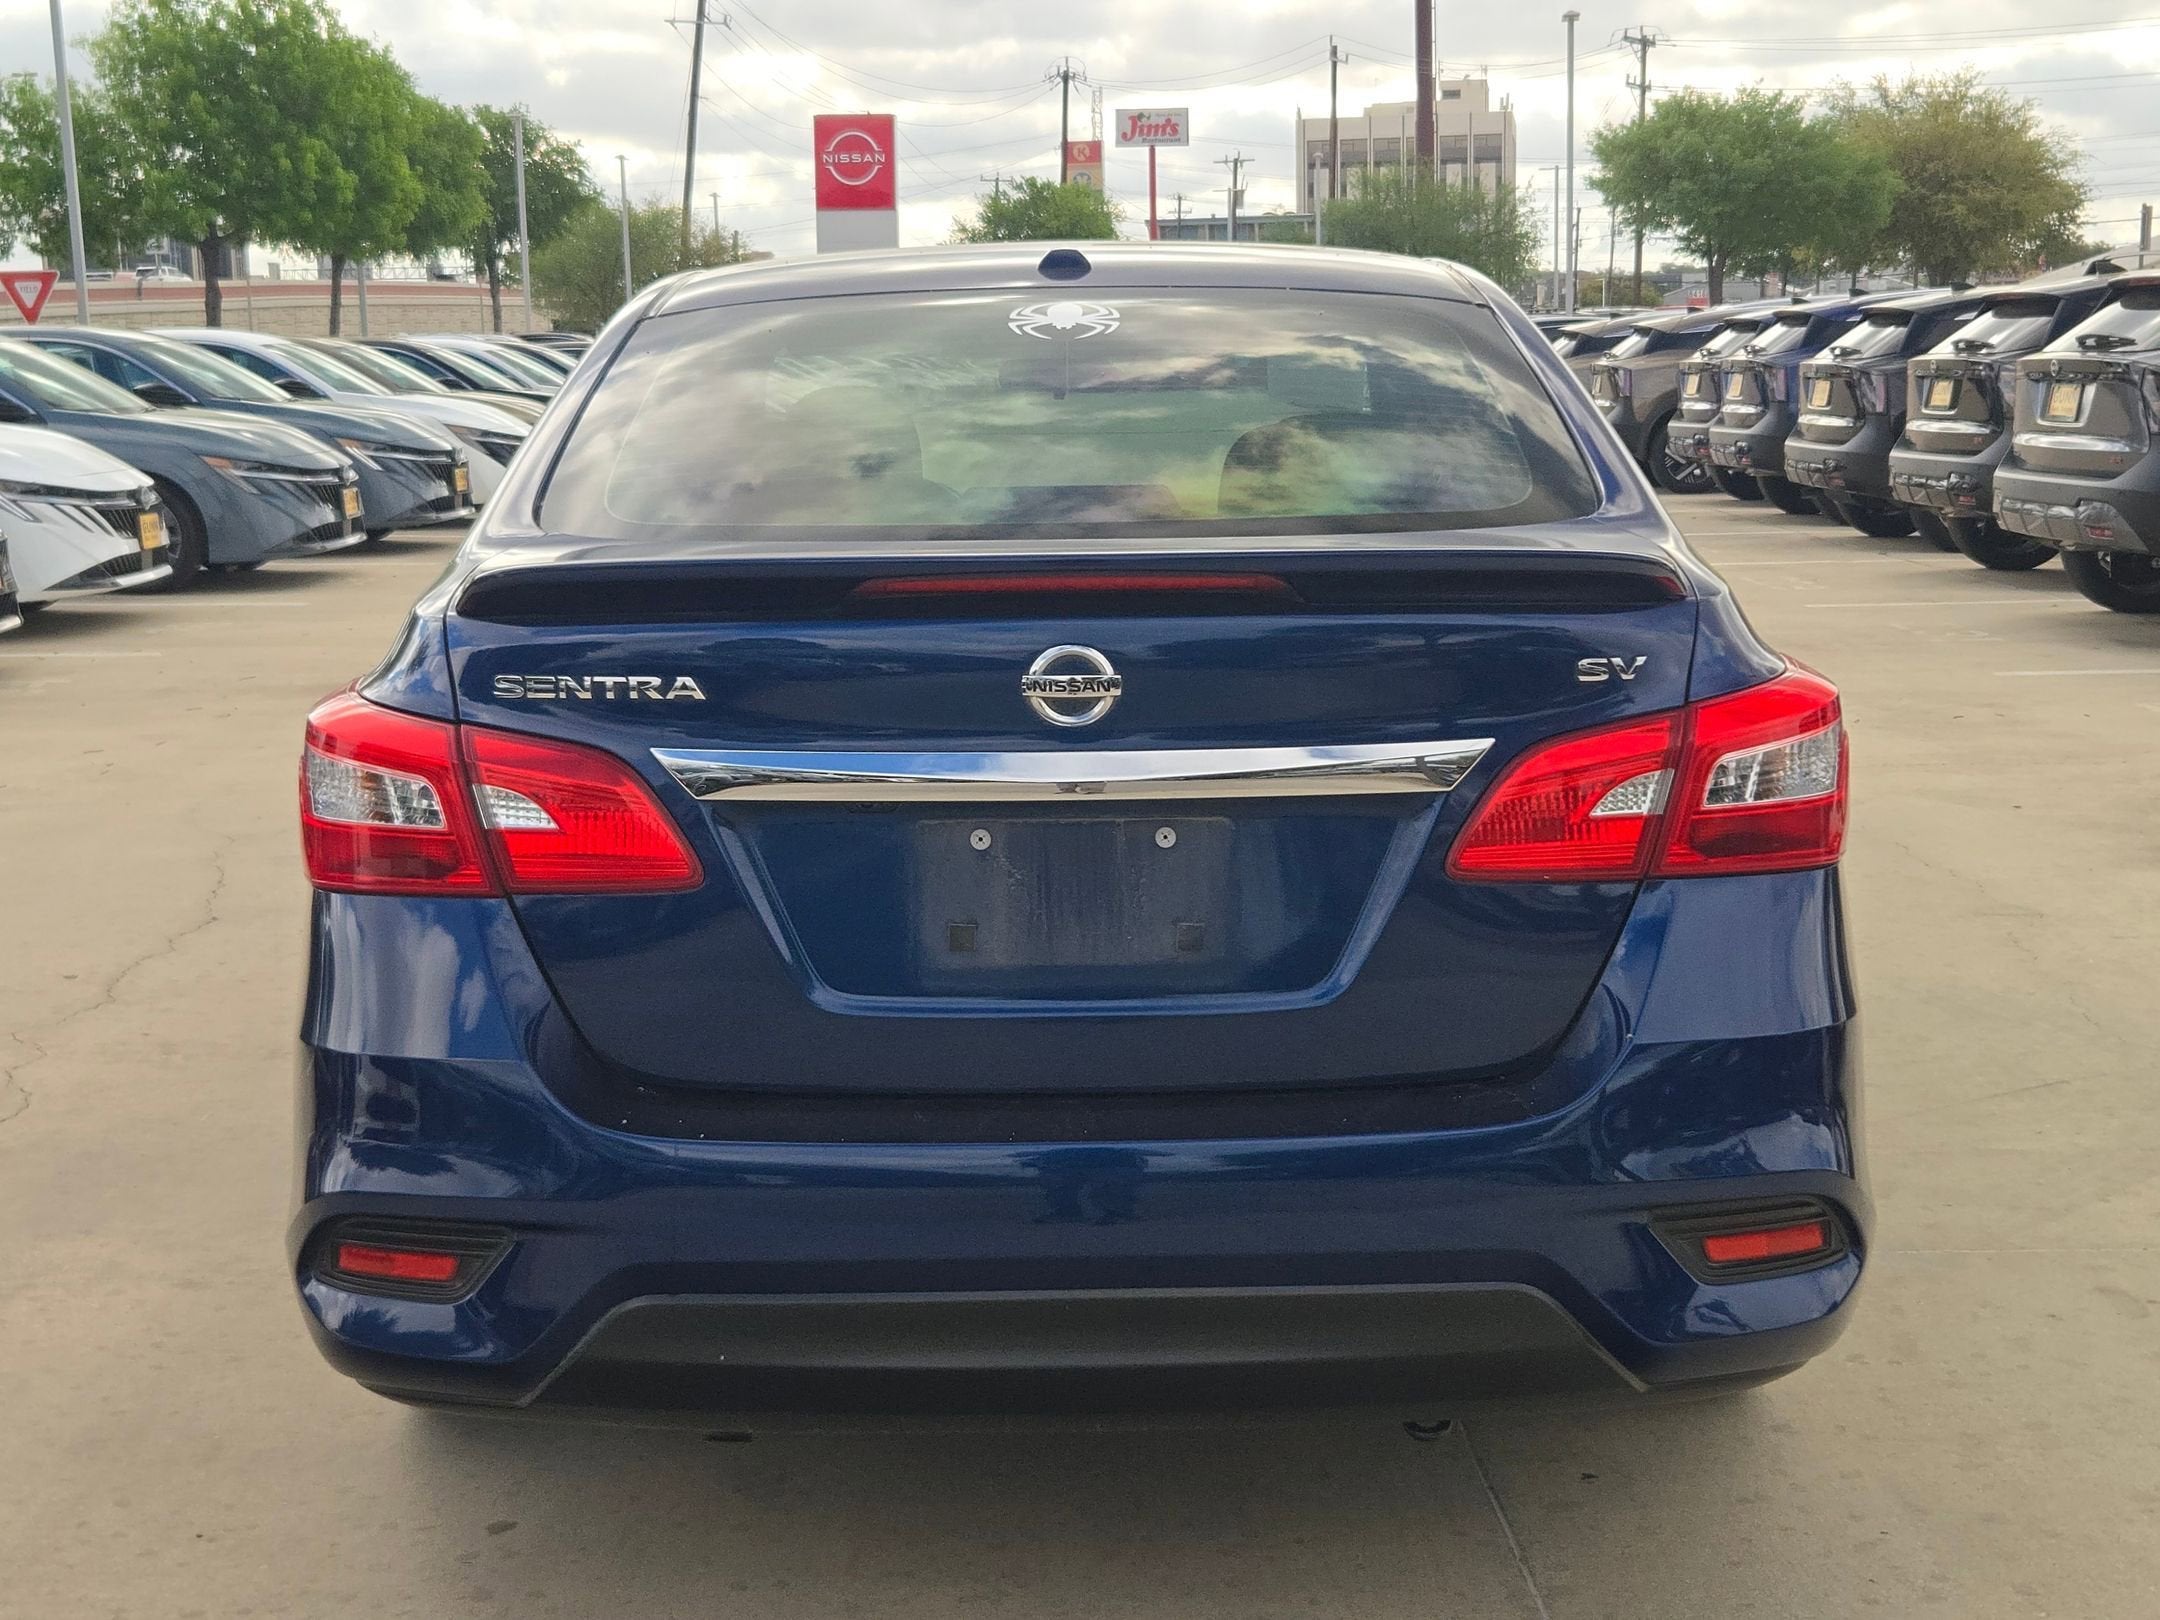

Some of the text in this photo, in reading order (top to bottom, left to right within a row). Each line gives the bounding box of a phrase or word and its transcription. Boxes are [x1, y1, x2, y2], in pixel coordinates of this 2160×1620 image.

[1121, 115, 1180, 142] Jim's
[823, 154, 885, 163] NISSAN
[1577, 656, 1648, 681] SV
[494, 675, 706, 700] SENTRA
[1032, 680, 1111, 693] NISSAN
